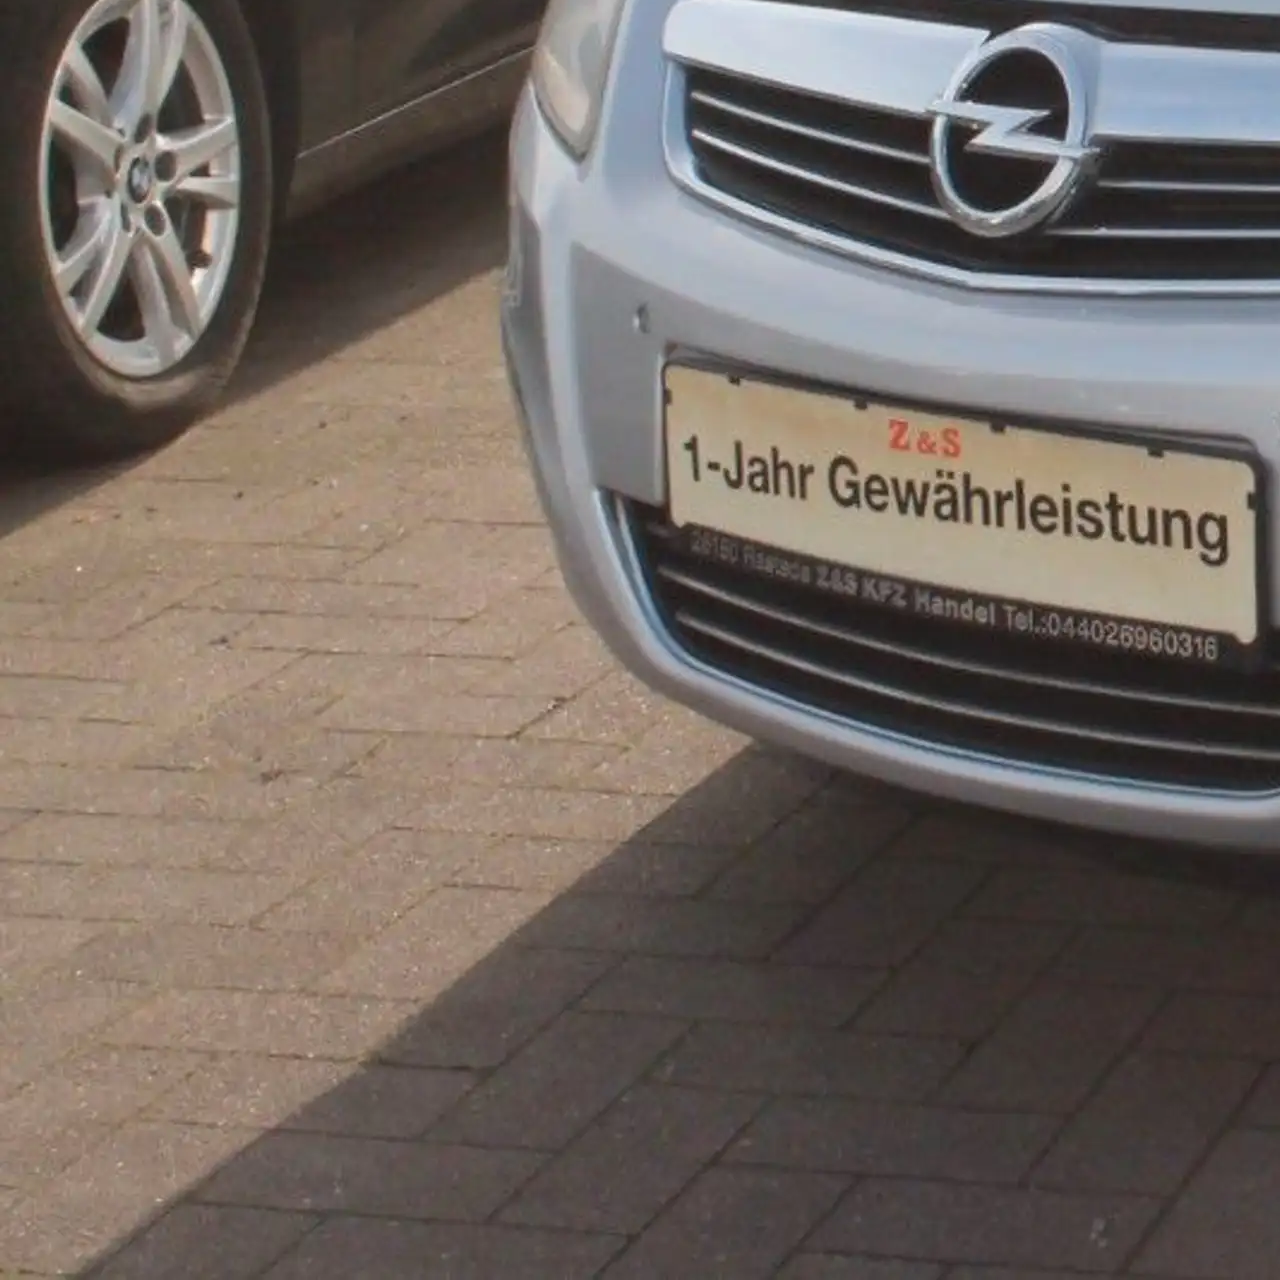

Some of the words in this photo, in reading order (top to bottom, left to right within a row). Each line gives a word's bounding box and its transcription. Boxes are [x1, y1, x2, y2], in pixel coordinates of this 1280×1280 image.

[684, 434, 815, 501] 1-Jahr
[827, 454, 1229, 567] Gewährleistung
[860, 577, 907, 609] KFZ
[913, 587, 996, 626] Handel
